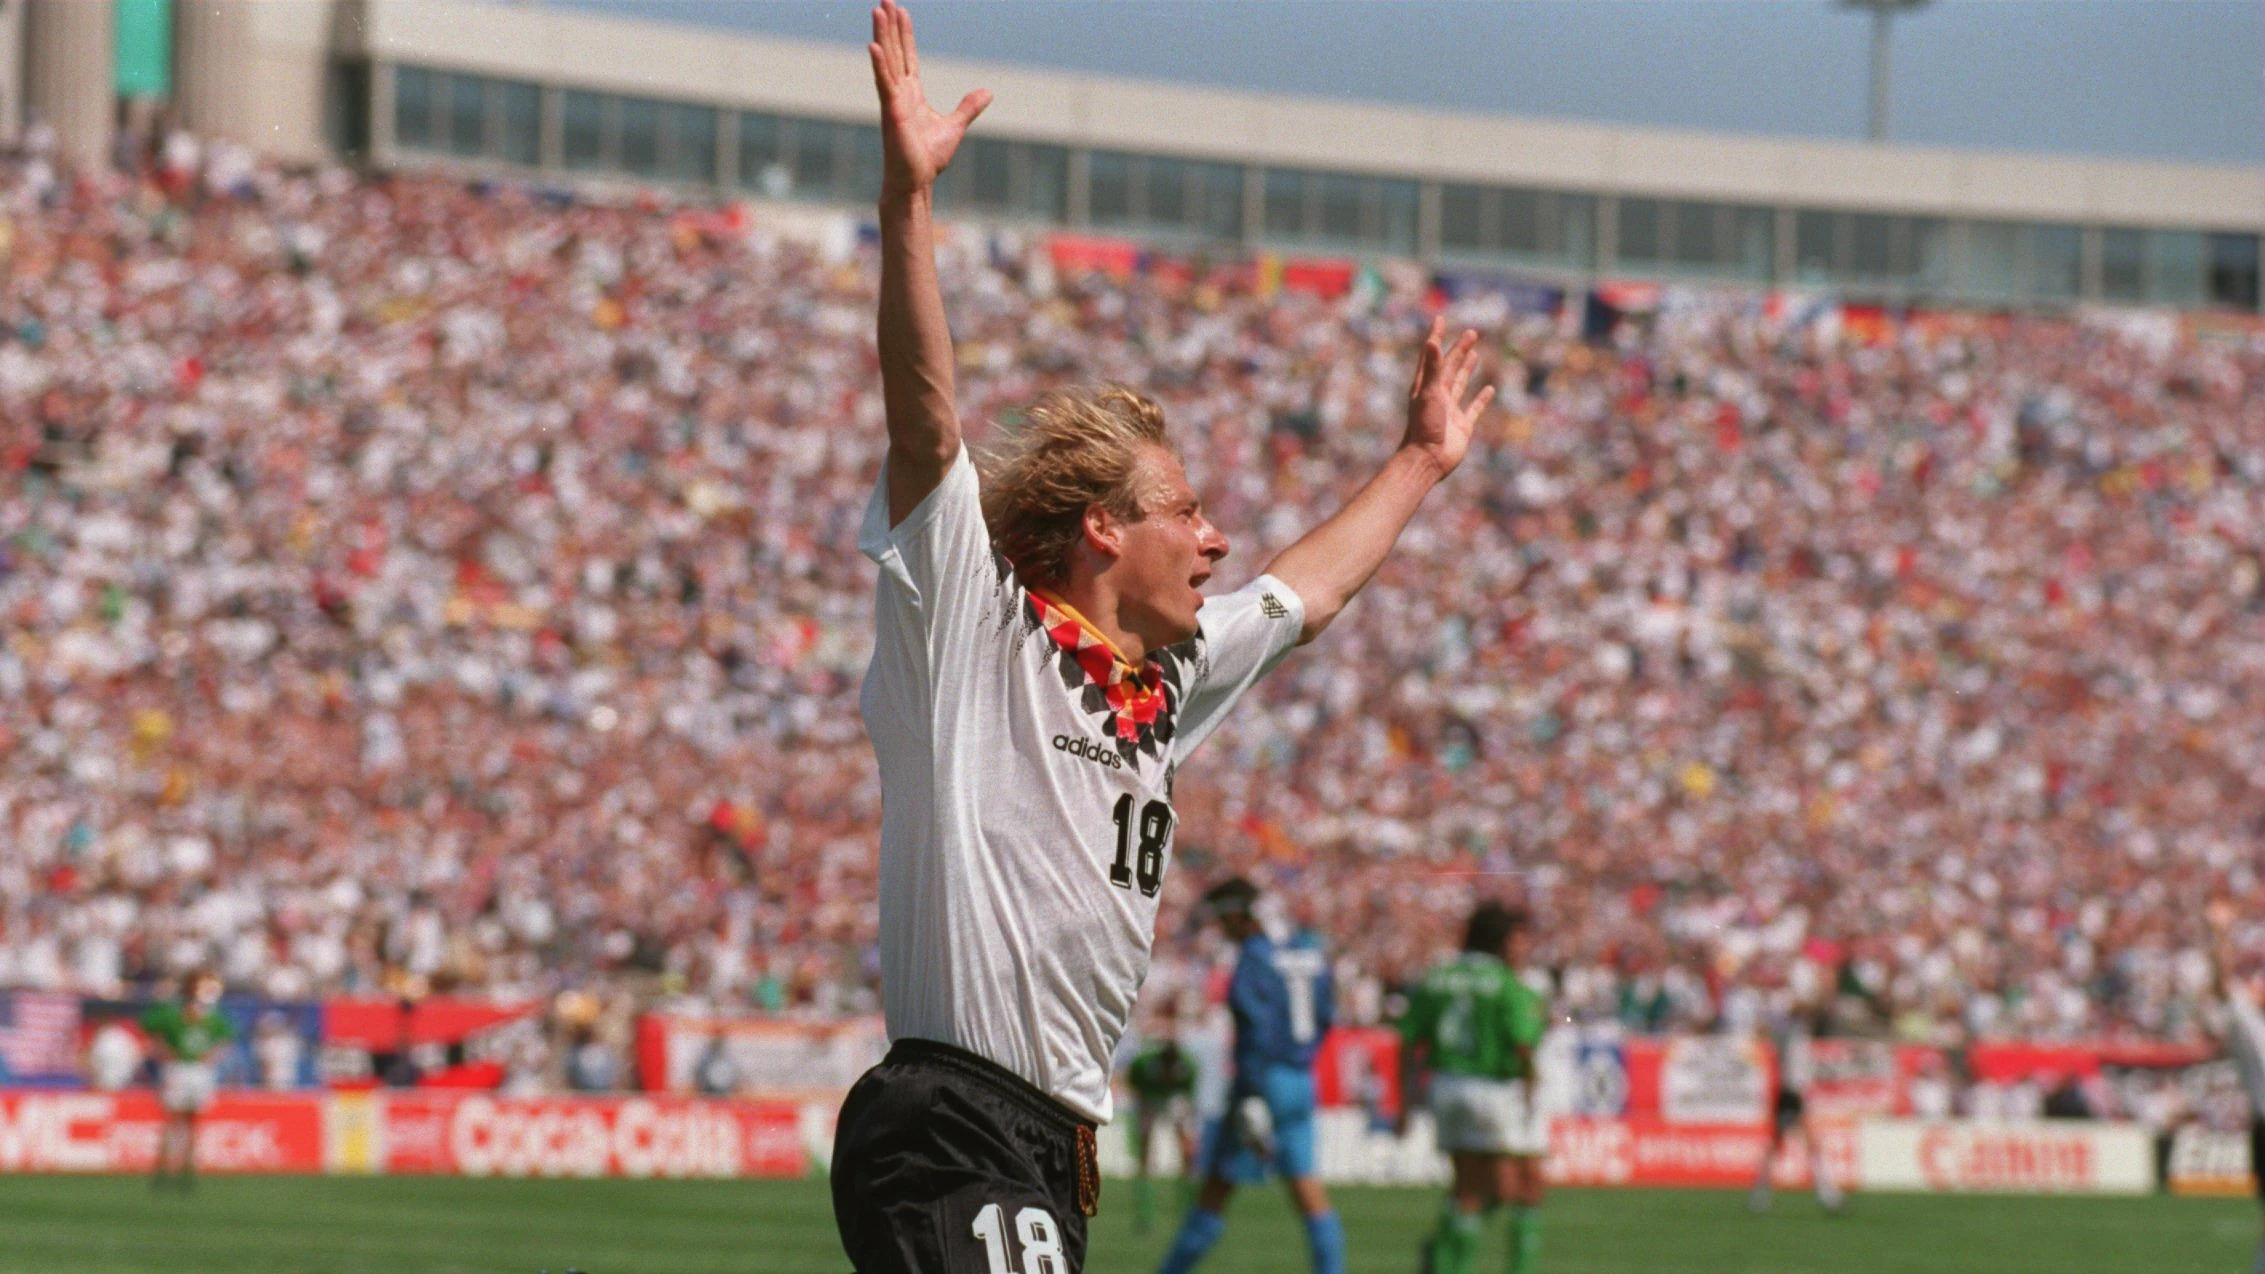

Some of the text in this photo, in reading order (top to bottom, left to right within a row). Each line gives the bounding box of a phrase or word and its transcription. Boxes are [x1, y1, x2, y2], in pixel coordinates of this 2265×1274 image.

[1052, 734, 1122, 769] adidas
[1111, 793, 1173, 898] 18
[453, 1096, 740, 1178] Coca-Cola
[972, 1203, 1069, 1274] 18
